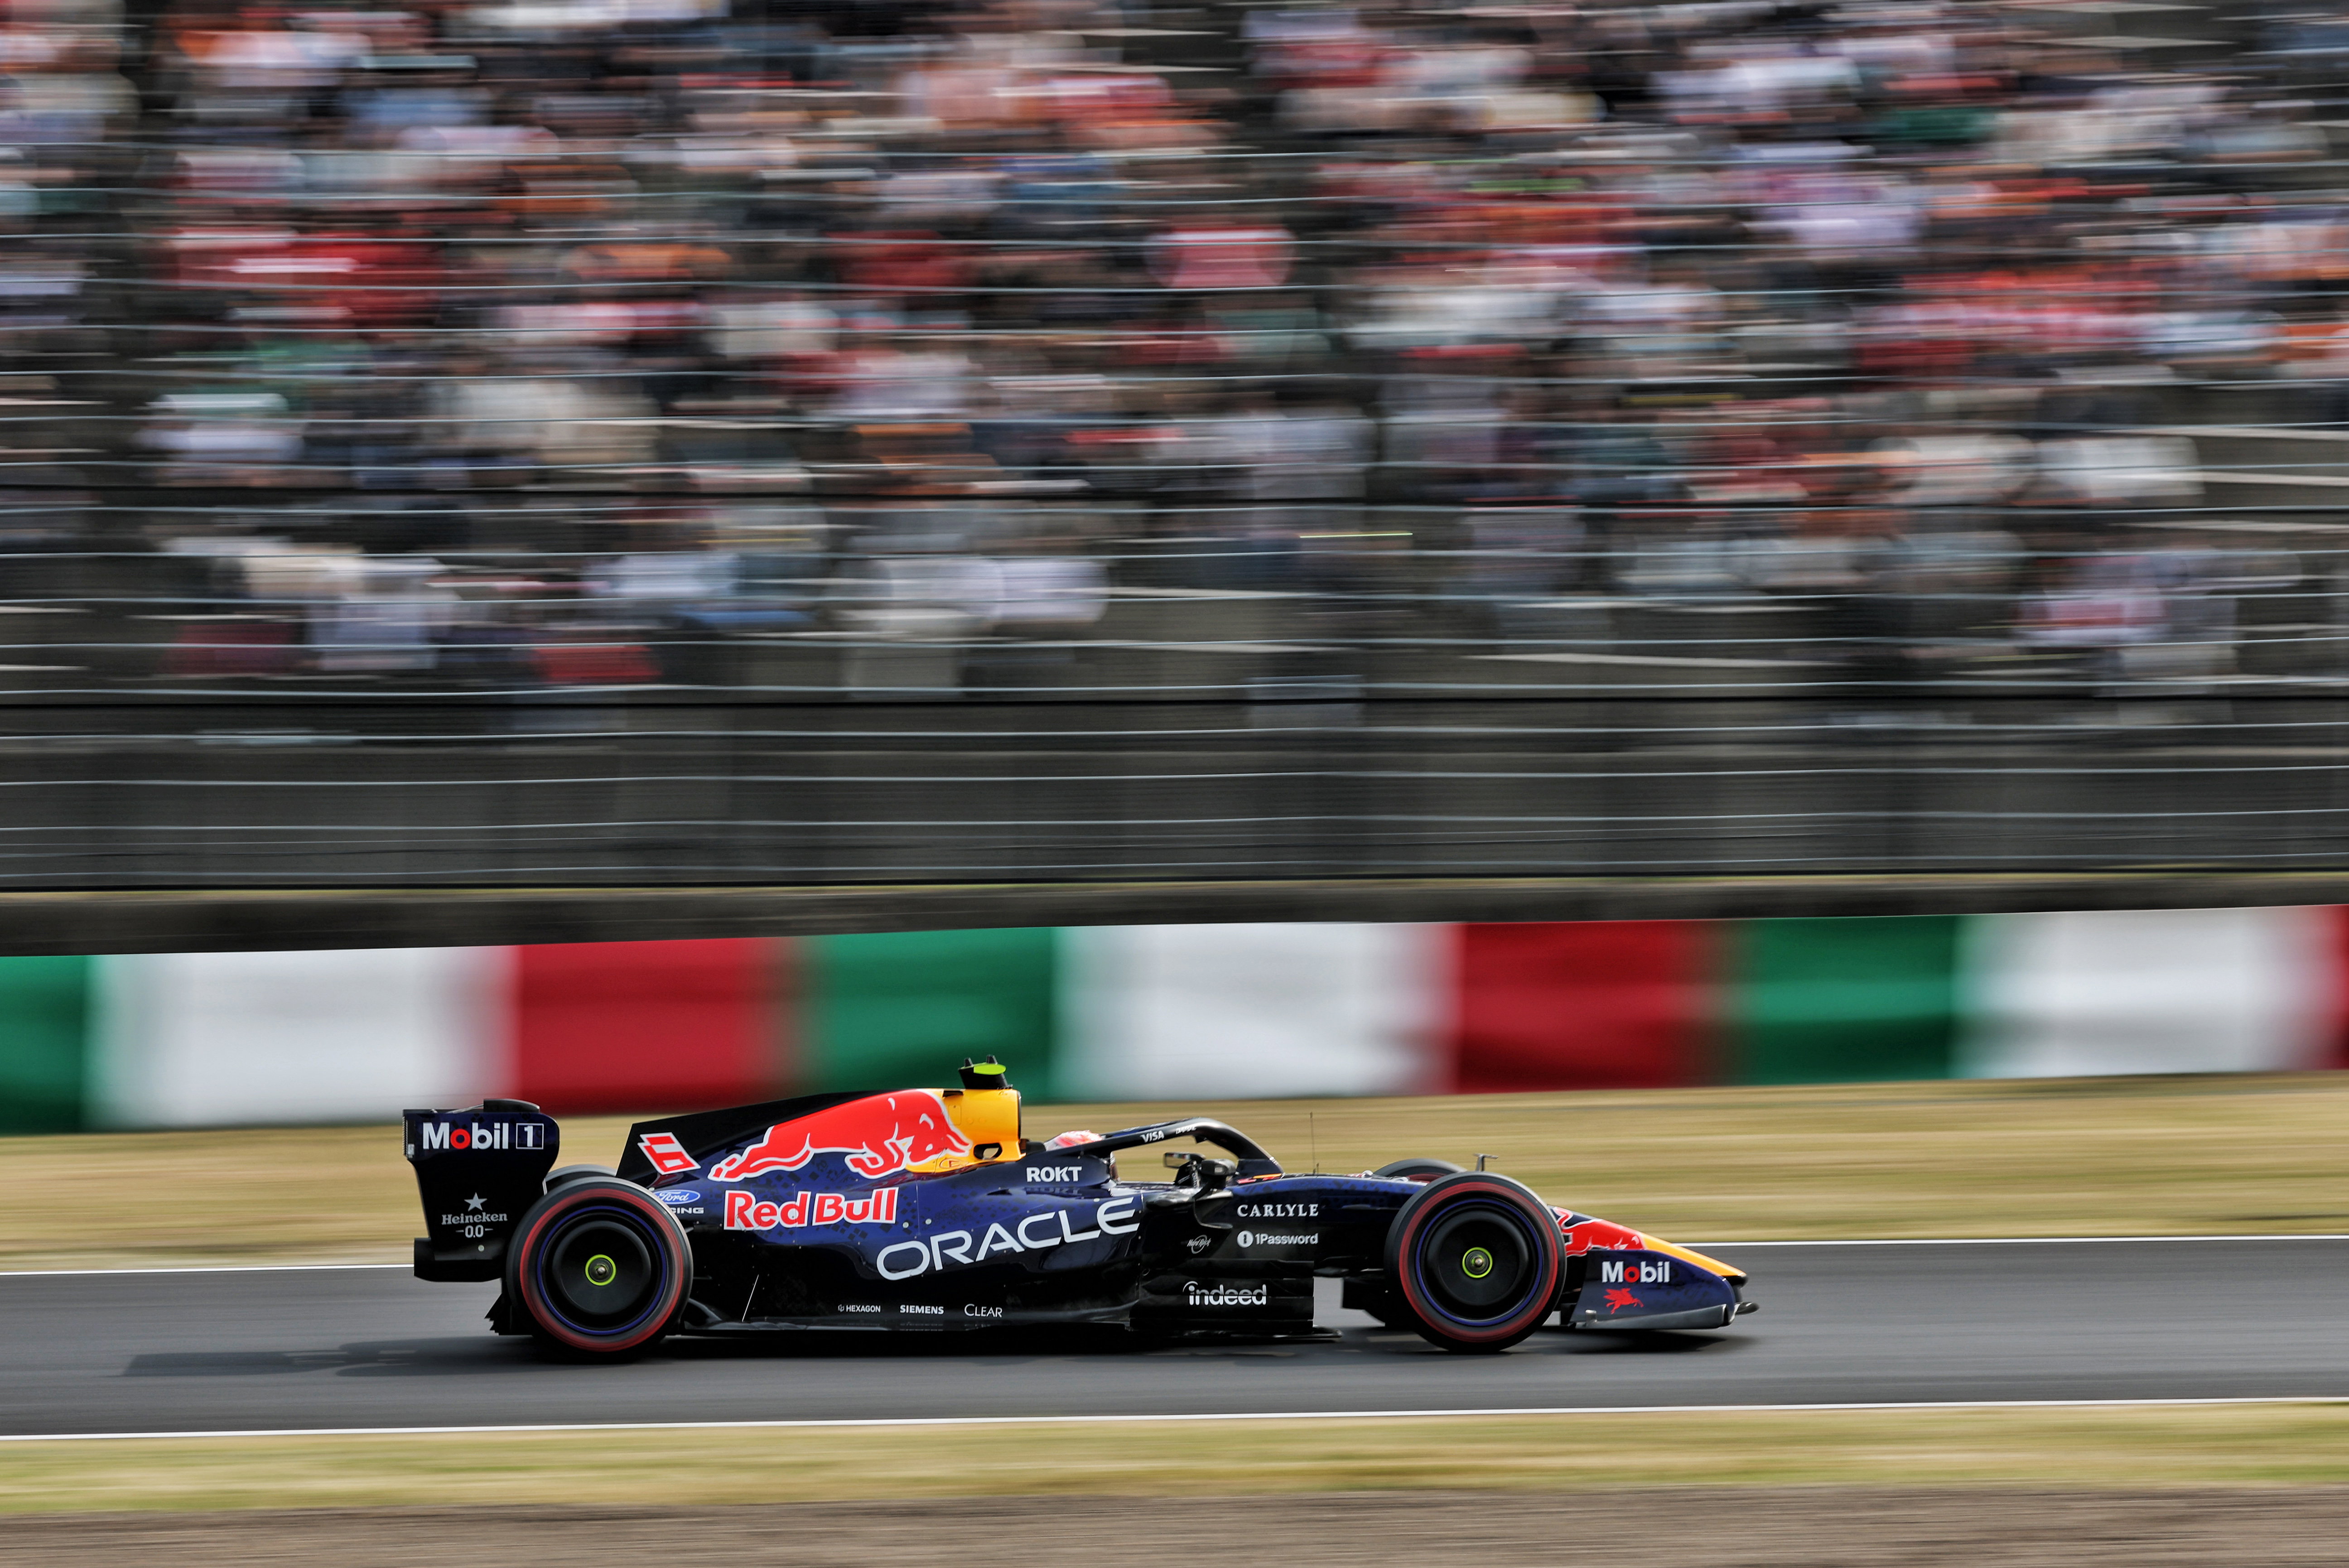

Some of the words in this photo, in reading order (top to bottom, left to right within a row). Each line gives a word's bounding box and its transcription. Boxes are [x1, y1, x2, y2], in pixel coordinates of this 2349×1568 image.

[423, 1122, 509, 1149] Mobil
[1140, 1130, 1164, 1143] VISA
[1026, 1166, 1082, 1182] ROKT
[658, 1192, 690, 1201] Ford
[725, 1191, 810, 1229] Red
[814, 1187, 898, 1225] Bull
[1237, 1204, 1319, 1217] CARLYLE
[441, 1210, 507, 1225] Heineken
[465, 1225, 484, 1238] 0.0
[877, 1197, 1140, 1280] ORACLE
[1187, 1239, 1201, 1247] Hard
[1255, 1233, 1318, 1245] 1Password
[1602, 1261, 1670, 1283] Mobil
[1183, 1281, 1267, 1305] indeed
[900, 1304, 944, 1314] SIEMENS
[964, 1303, 1003, 1317] CLEAR
